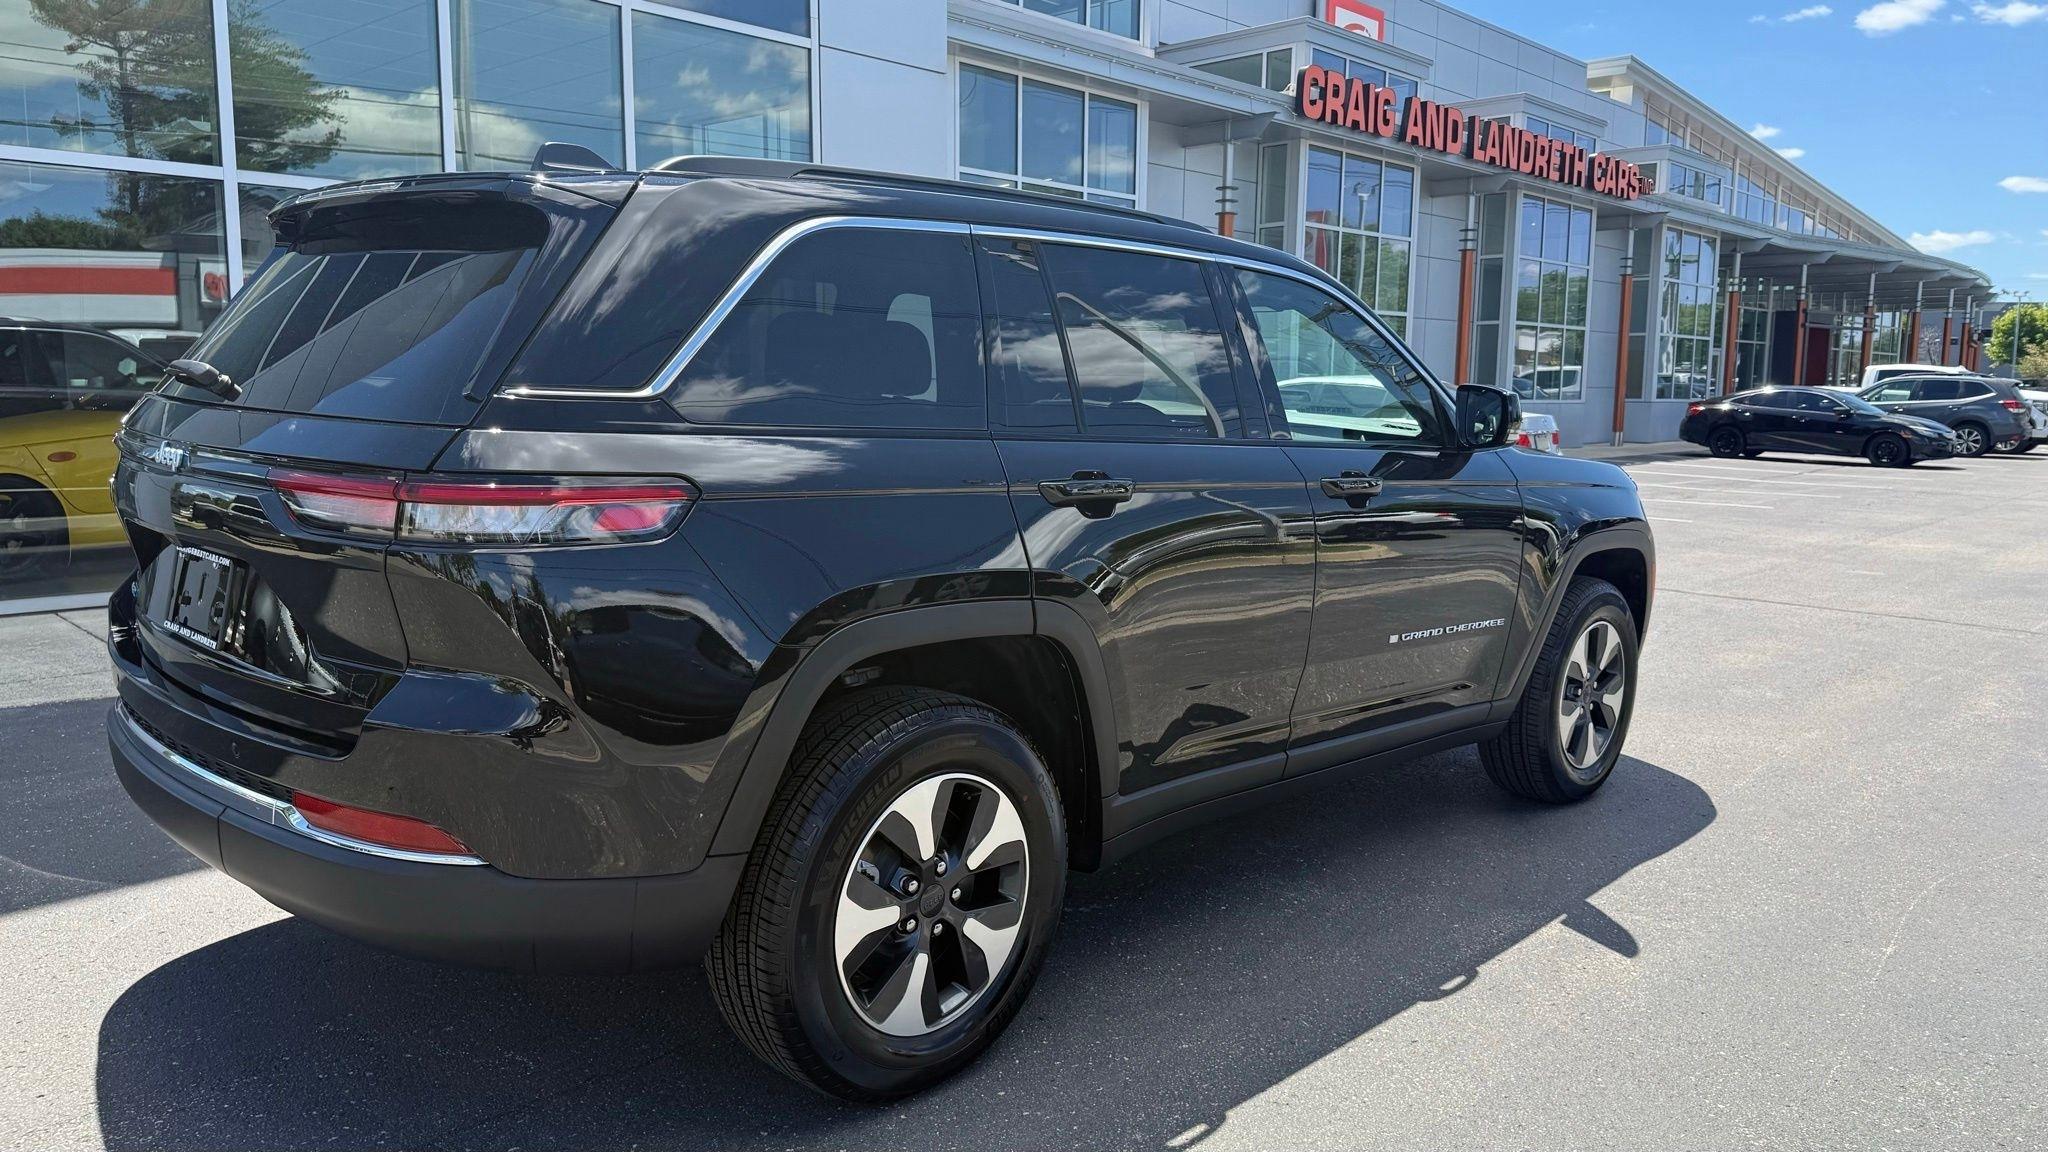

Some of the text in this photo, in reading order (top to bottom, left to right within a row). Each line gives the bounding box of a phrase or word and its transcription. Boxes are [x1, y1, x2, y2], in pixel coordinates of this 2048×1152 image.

[1299, 65, 1396, 138] CRAIG
[1403, 96, 1464, 154] AND
[1471, 115, 1588, 188] LANDRETH
[1592, 152, 1640, 200] CARS
[155, 440, 183, 472] Jeep
[163, 620, 217, 650] CRAIG AND LANDRETH
[1401, 618, 1505, 641] GRAND CHEROKEE
[831, 761, 902, 857] MICHELIN
